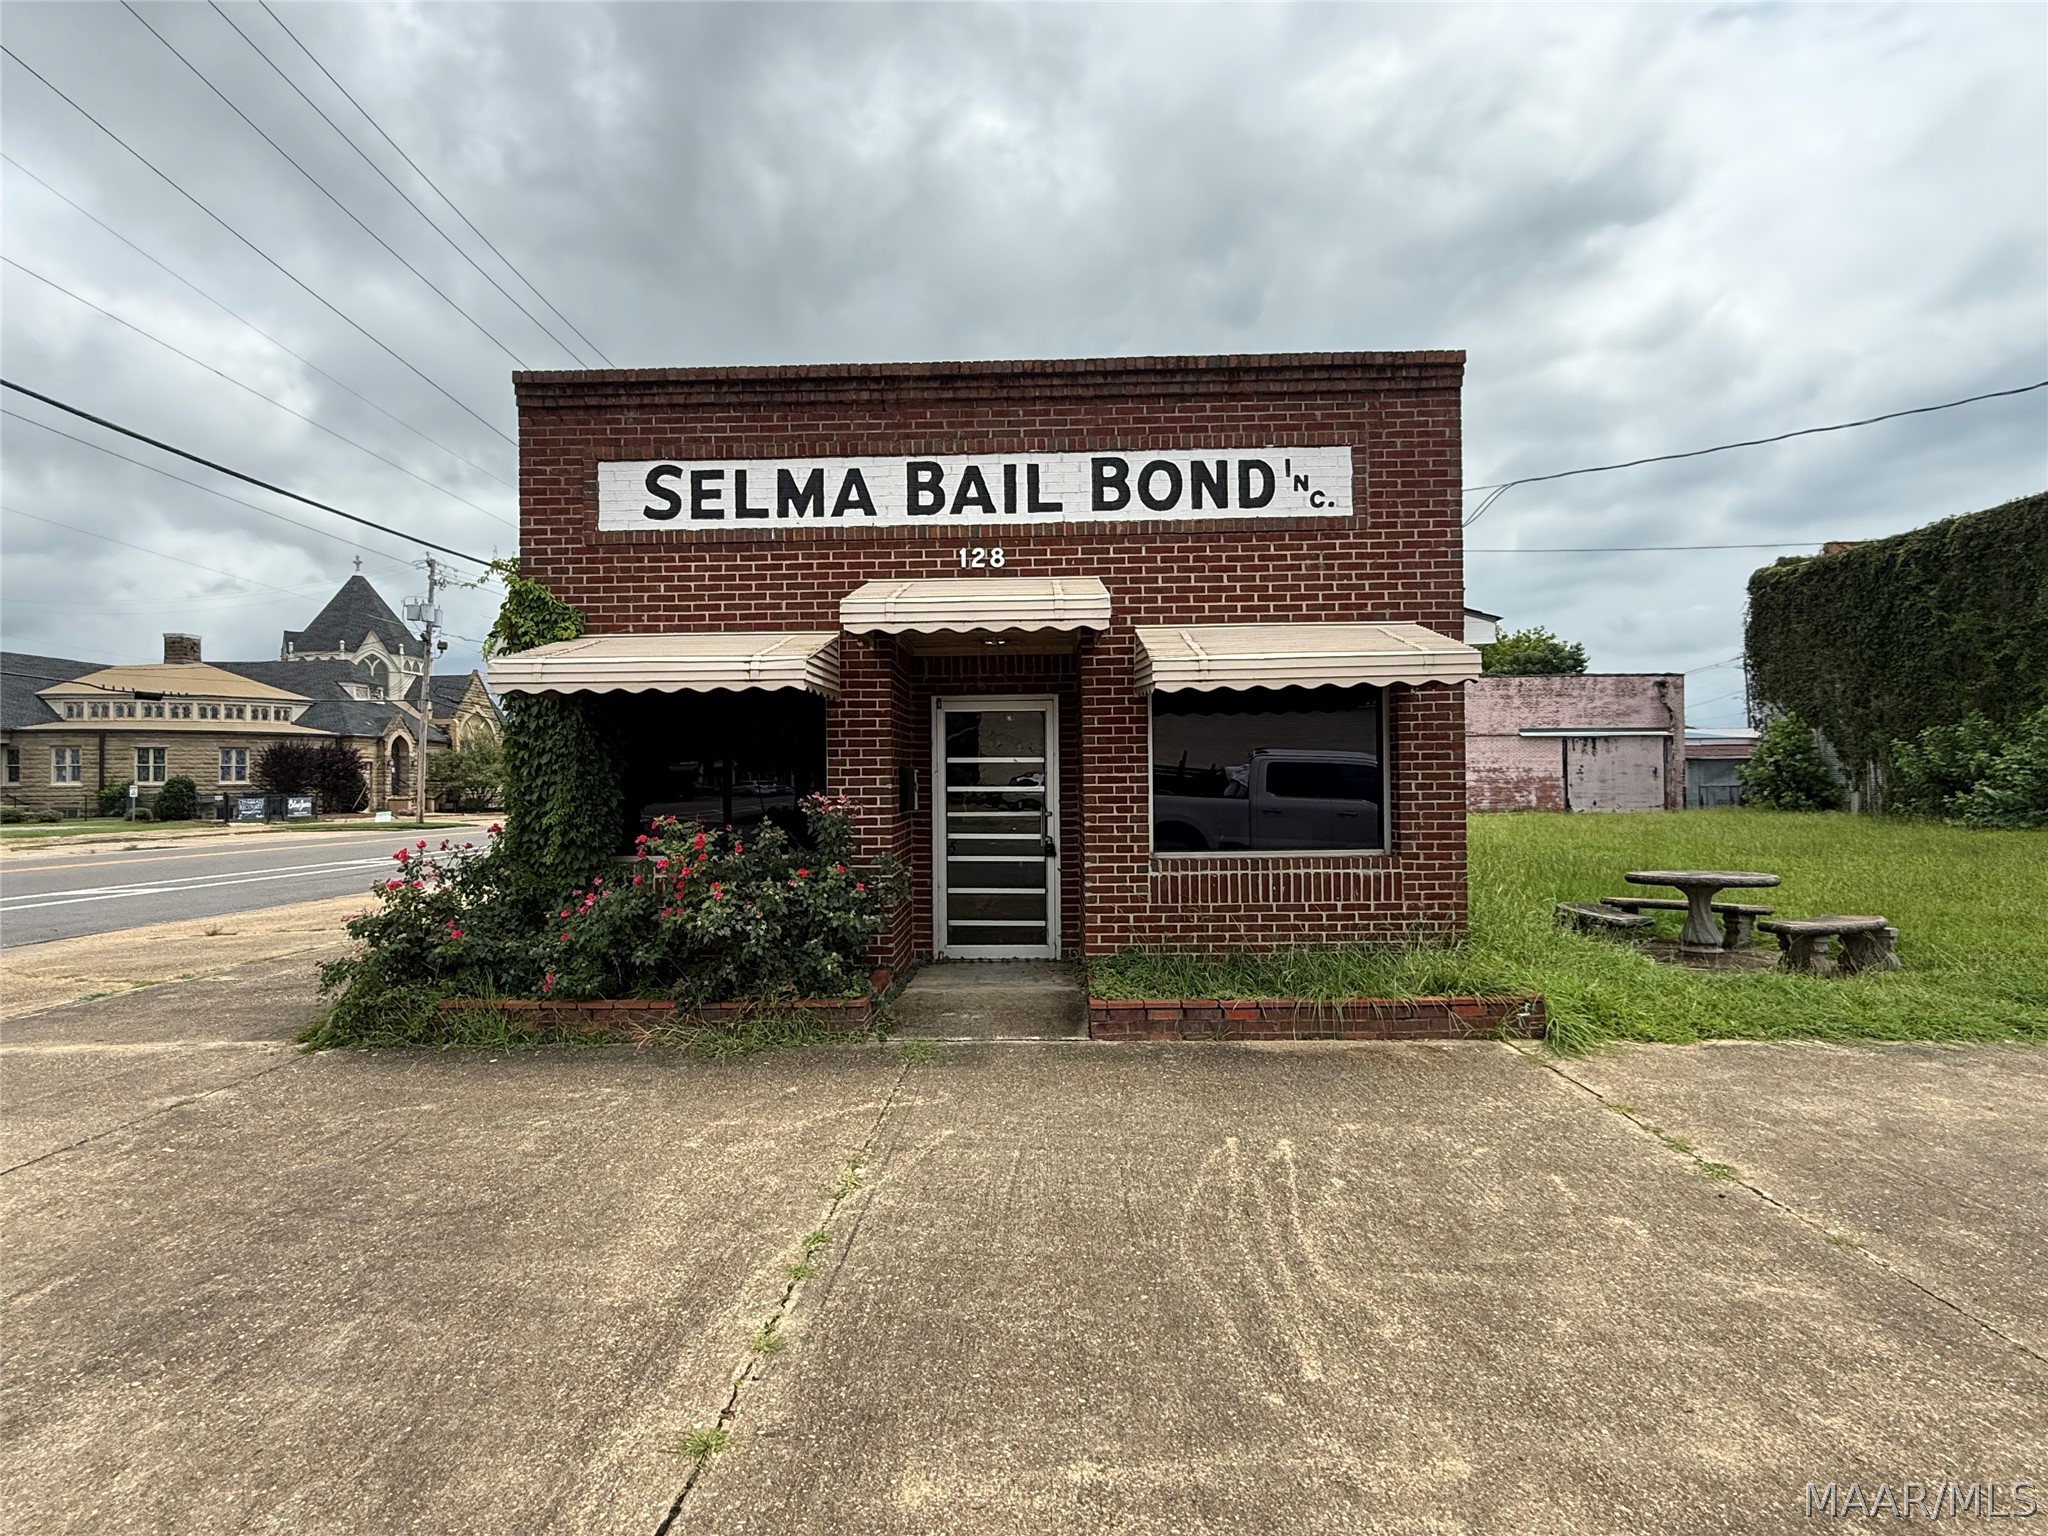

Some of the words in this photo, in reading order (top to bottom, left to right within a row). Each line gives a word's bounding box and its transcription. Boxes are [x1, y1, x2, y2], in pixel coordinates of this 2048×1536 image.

[643, 464, 877, 520] SELMA
[906, 461, 1063, 516] BAIL
[1091, 457, 1276, 511] BOND
[959, 547, 1006, 569] 128
